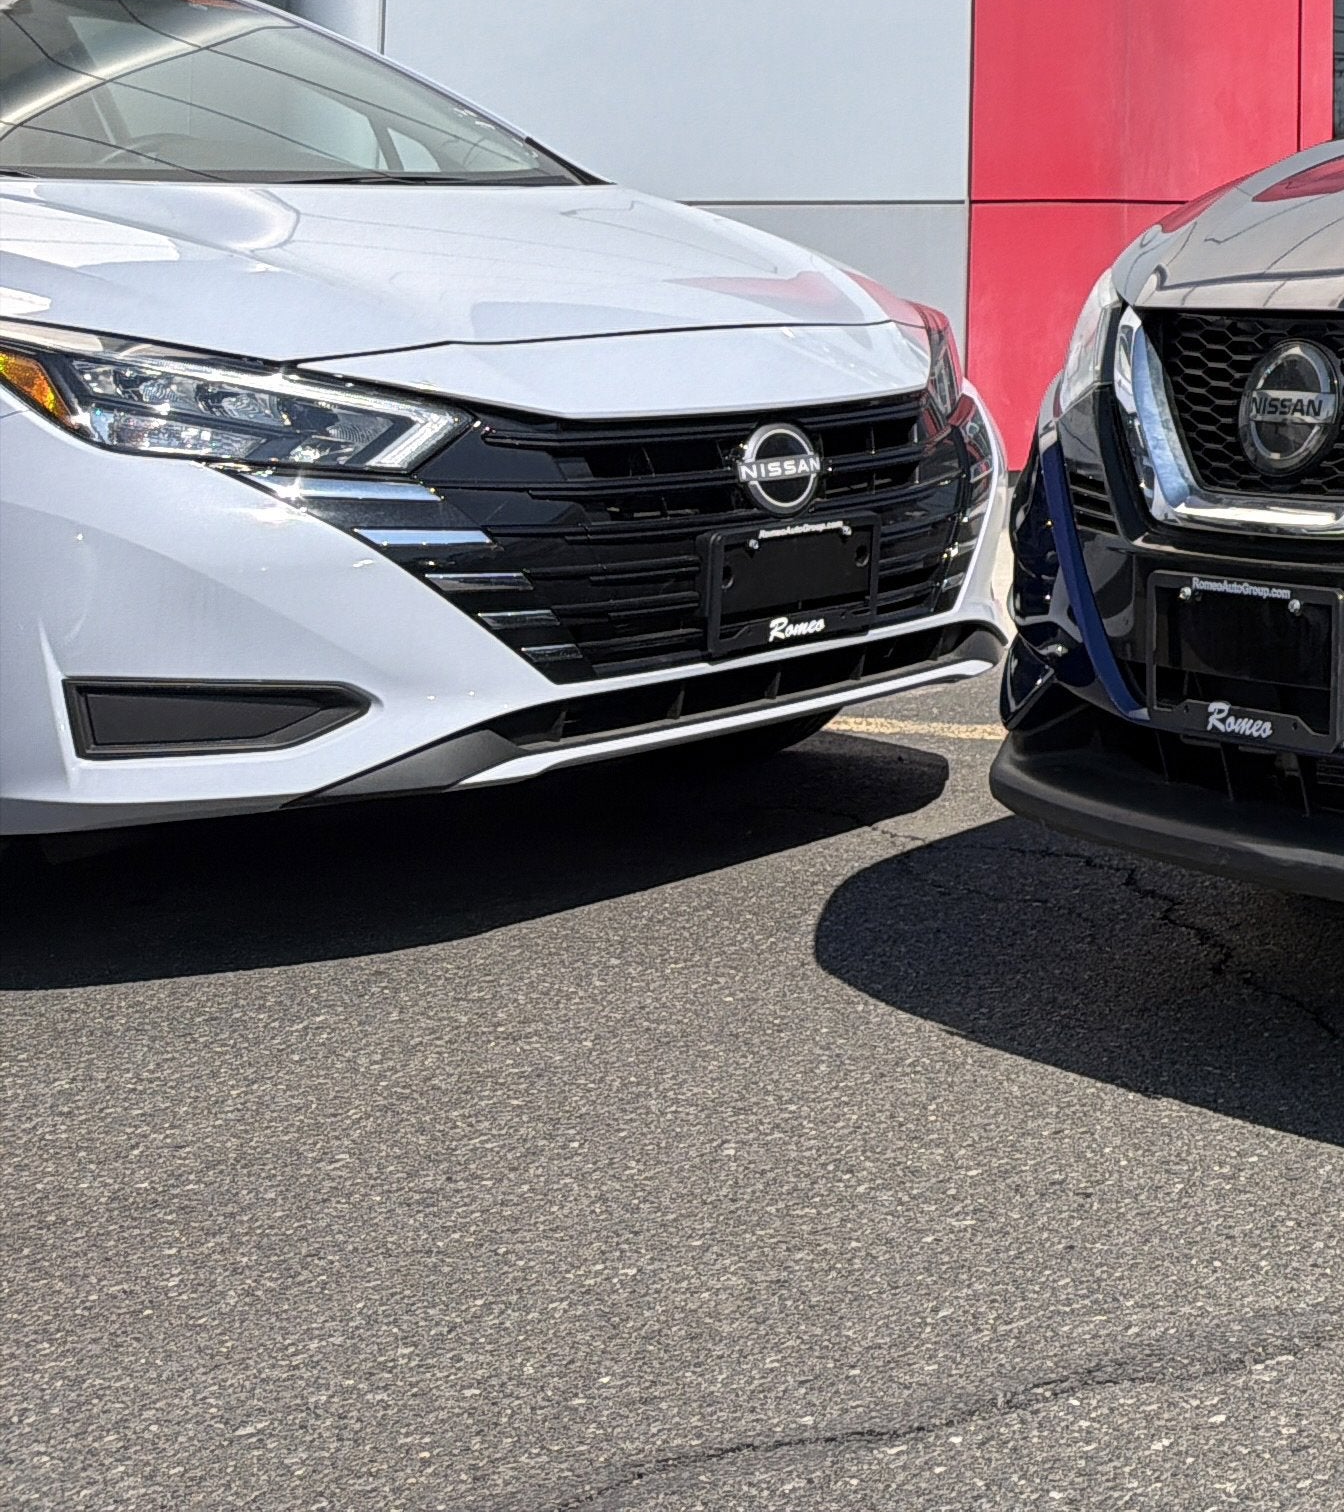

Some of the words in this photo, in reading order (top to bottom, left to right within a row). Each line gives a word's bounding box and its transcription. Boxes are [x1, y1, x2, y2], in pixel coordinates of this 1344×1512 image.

[1251, 396, 1323, 417] NISSAN
[740, 457, 821, 481] NISSAN
[1191, 576, 1291, 600] RomeoAutoGroup.com
[768, 616, 826, 643] Romeo
[1206, 701, 1273, 739] Romeo
